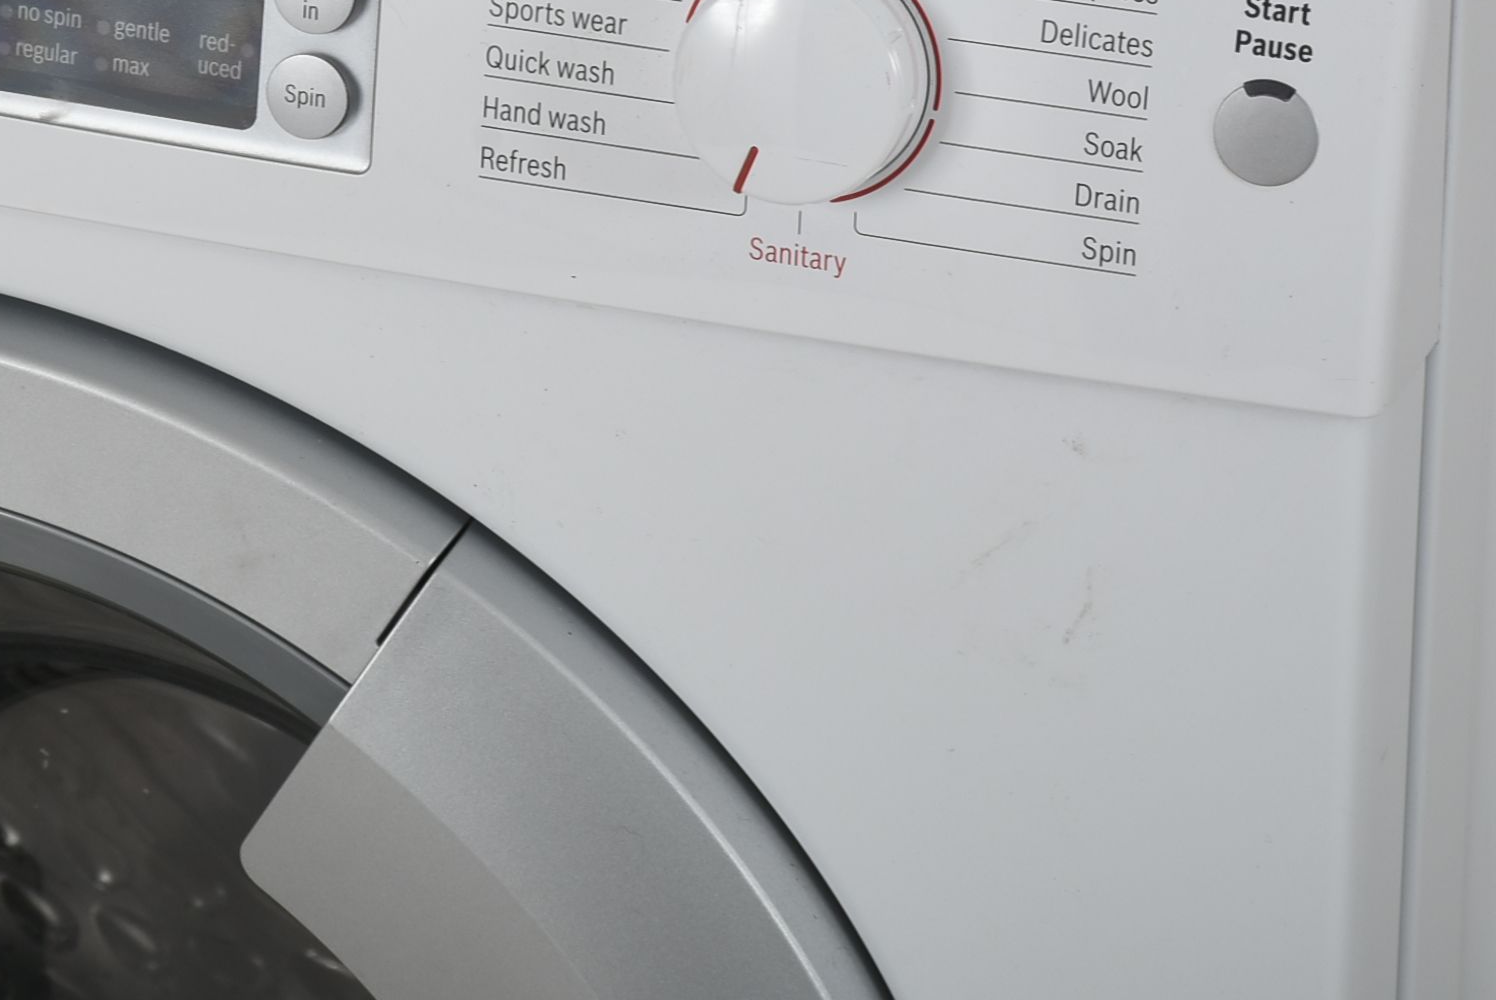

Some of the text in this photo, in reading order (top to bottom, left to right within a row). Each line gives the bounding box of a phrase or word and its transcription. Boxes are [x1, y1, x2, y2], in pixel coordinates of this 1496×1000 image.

[17, 3, 82, 29] no spin
[303, 0, 319, 20] in
[572, 10, 628, 35] wear
[114, 18, 170, 44] gentle
[199, 32, 236, 53] red-
[1040, 20, 1154, 58] Delicates
[1234, 29, 1313, 63] Pause
[15, 40, 78, 65] regular
[112, 56, 150, 76] max
[485, 45, 615, 85] Quick wash
[198, 58, 242, 80] uced
[284, 84, 326, 108] Spin
[1088, 79, 1149, 111] Wool
[482, 96, 606, 135] Hand wash
[480, 146, 567, 180] Refresh
[1083, 133, 1143, 163] Soak
[1075, 183, 1140, 215] Drain
[748, 237, 846, 278] Sanitary
[1081, 237, 1137, 267] Spin
